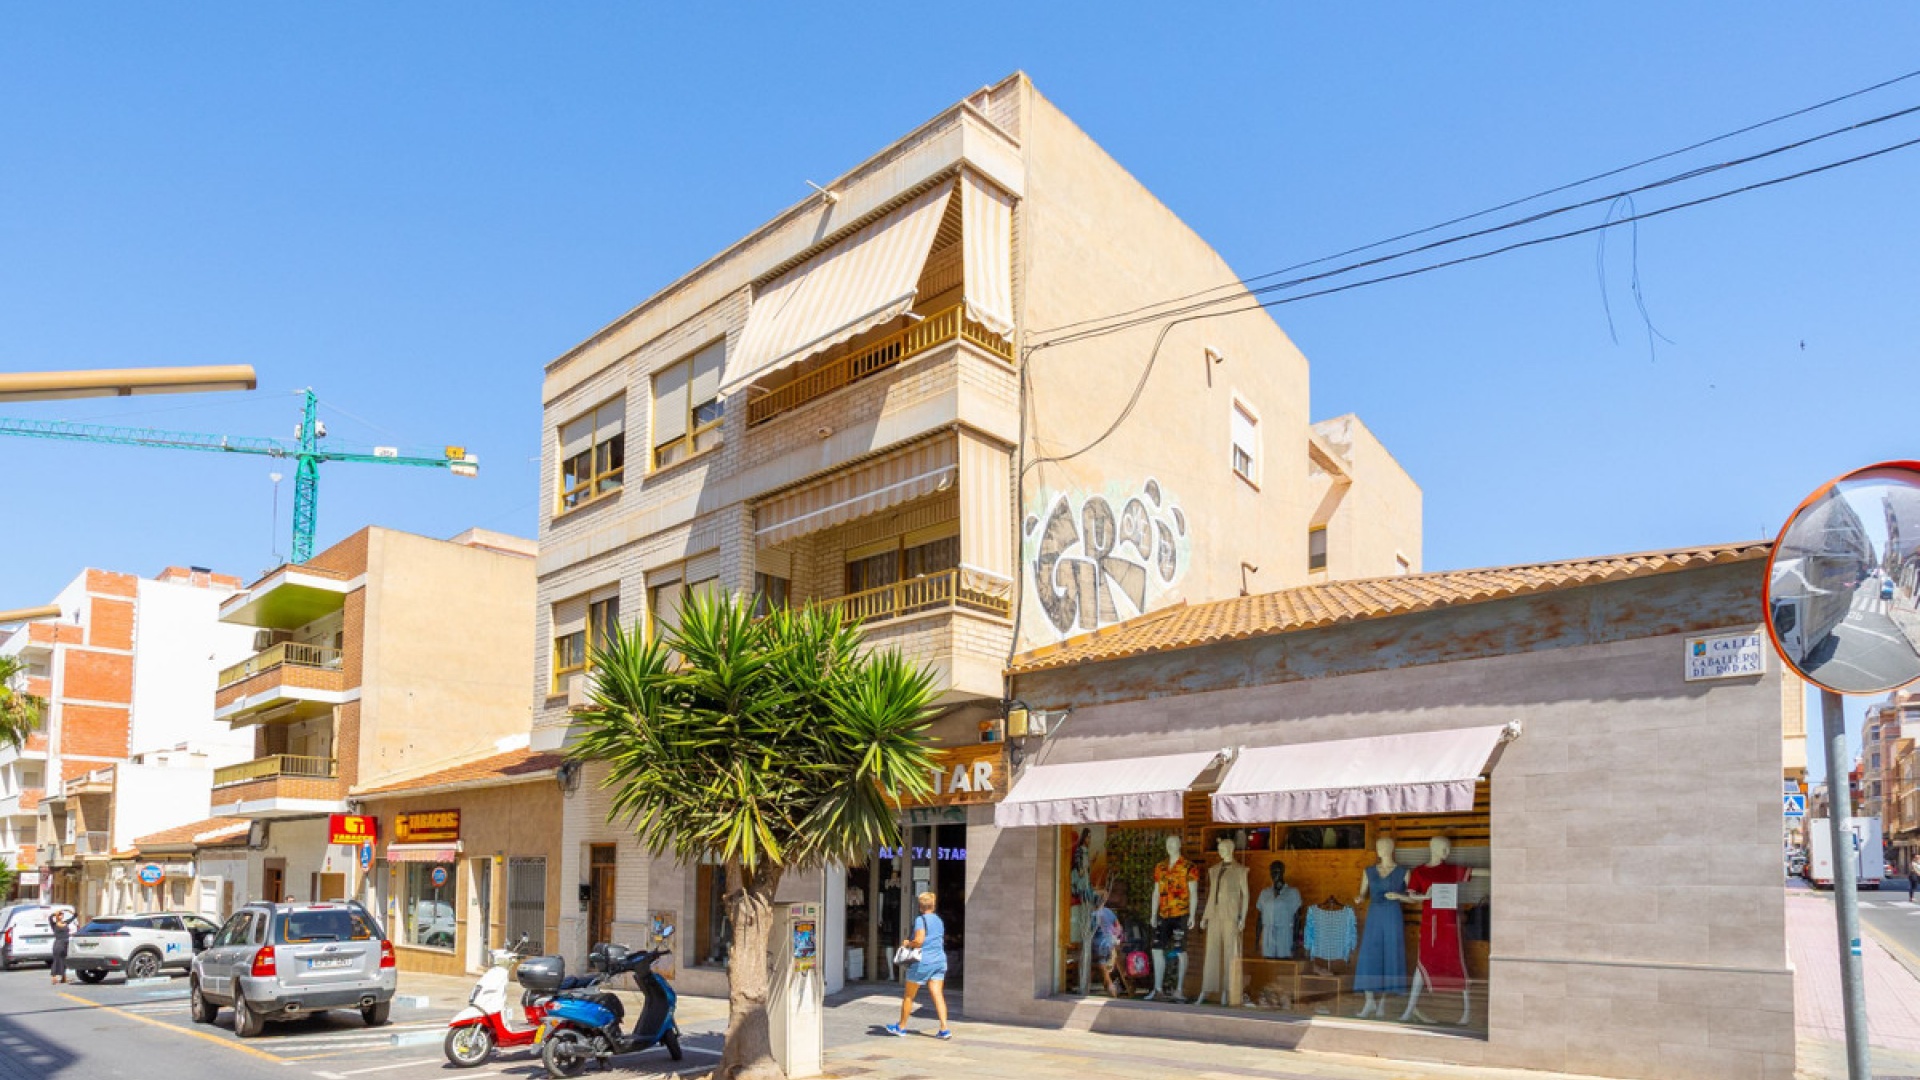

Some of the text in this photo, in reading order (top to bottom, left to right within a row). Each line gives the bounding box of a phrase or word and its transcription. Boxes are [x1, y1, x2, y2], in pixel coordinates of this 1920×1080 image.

[1713, 637, 1759, 650] CALLE
[1692, 652, 1758, 667] CABALLERO
[1716, 663, 1756, 675] RODAS
[919, 761, 994, 795] TAR
